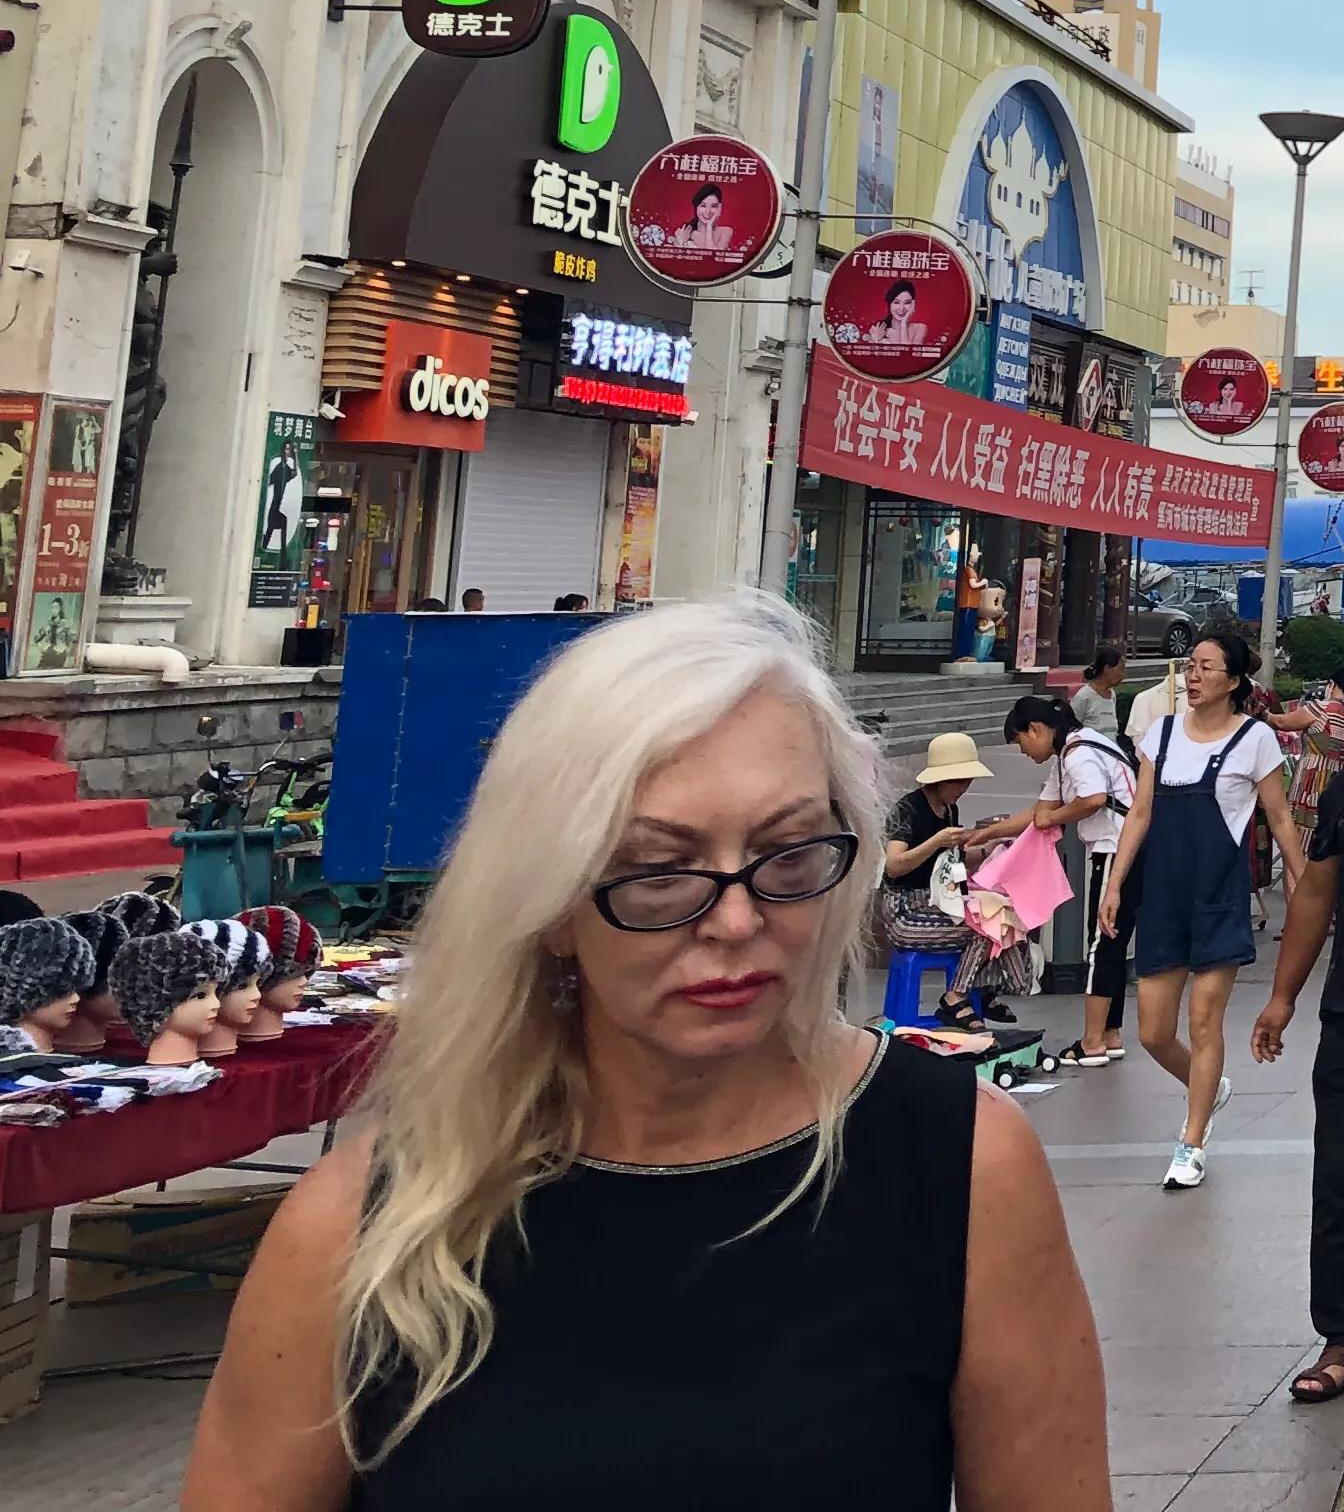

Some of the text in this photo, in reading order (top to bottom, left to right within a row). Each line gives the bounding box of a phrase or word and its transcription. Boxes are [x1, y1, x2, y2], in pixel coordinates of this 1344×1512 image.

[426, 11, 514, 38] 德克士
[659, 152, 759, 176] 六桂福珠宝
[531, 158, 629, 247] 德克士
[553, 249, 598, 283] 脆皮炸鸡
[852, 250, 951, 271] 六桂福珠宝
[1197, 357, 1257, 372] 六桂福珠宝
[409, 354, 490, 421] dicos
[832, 375, 1157, 522] 社会平安 人人受益 扫黑除恶 人人有责
